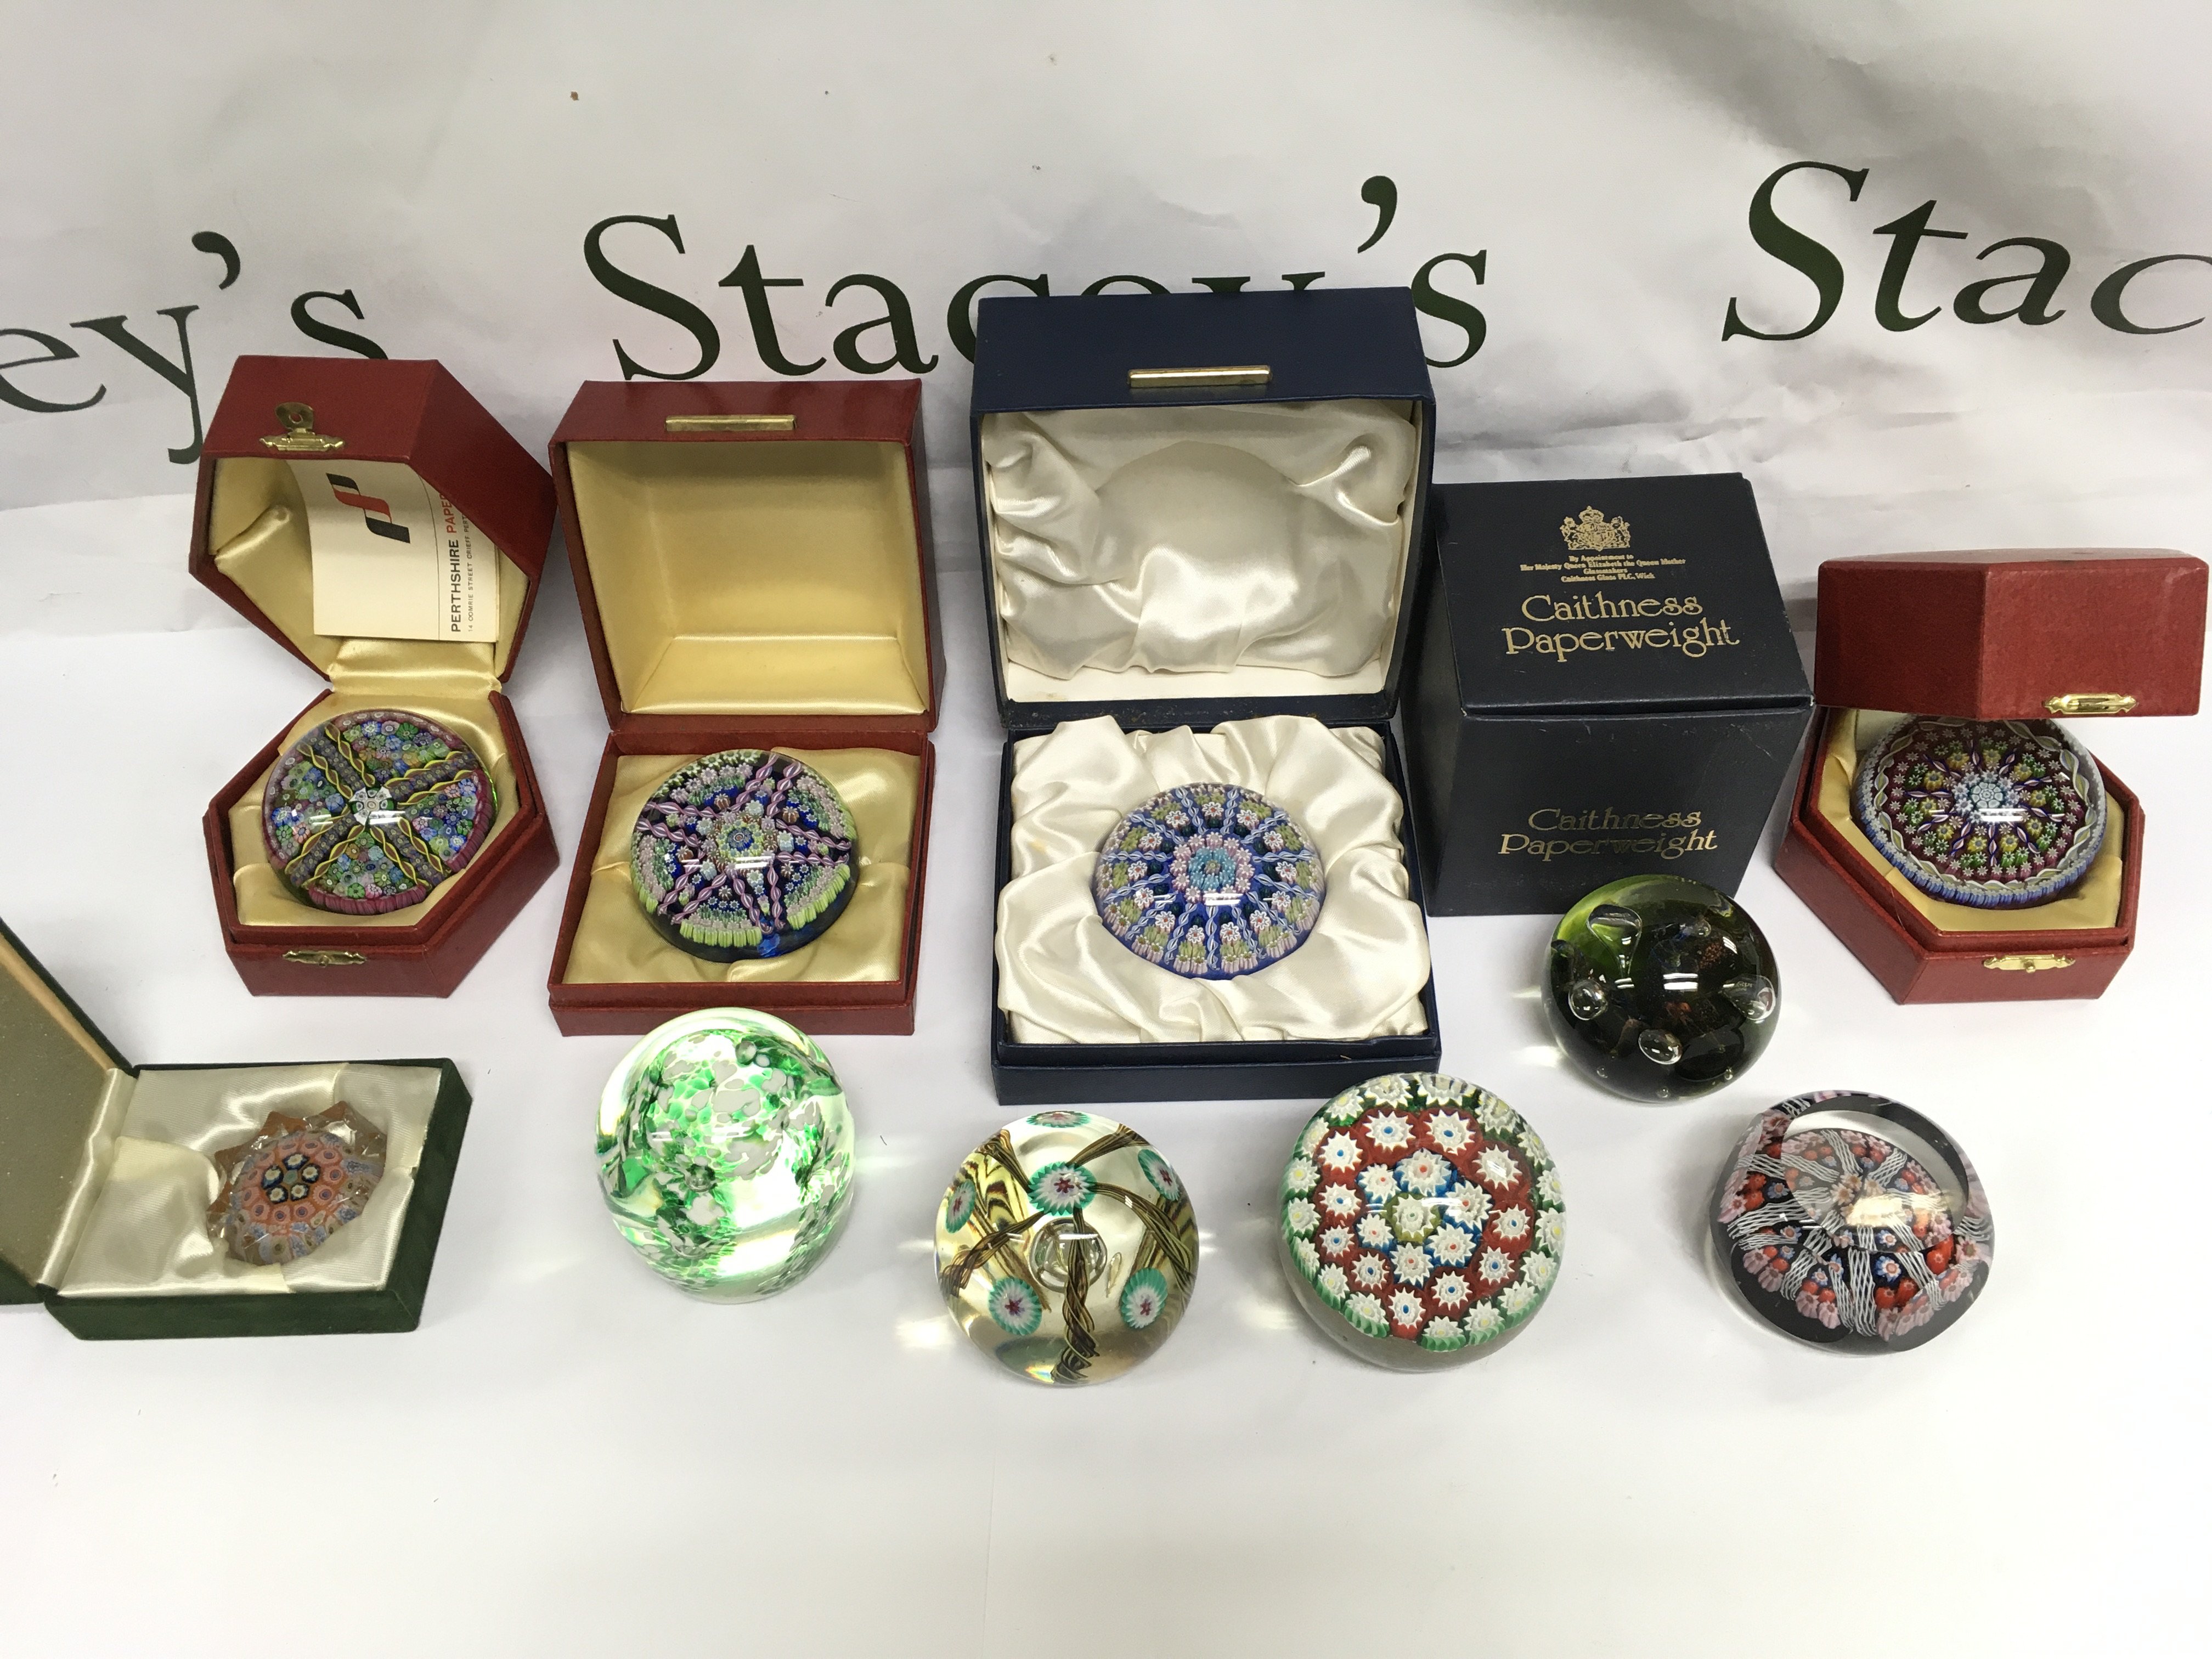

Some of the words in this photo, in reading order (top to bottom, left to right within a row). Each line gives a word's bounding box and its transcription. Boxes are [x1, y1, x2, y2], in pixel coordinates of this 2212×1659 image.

[583, 174, 1488, 381] Stac's
[448, 539, 461, 632] PERTHSHIRE
[1522, 591, 1703, 622] Caithness
[1502, 617, 1740, 663] Paperweight
[1528, 806, 1701, 831] Caithness
[1498, 828, 1718, 862] Paperweight
